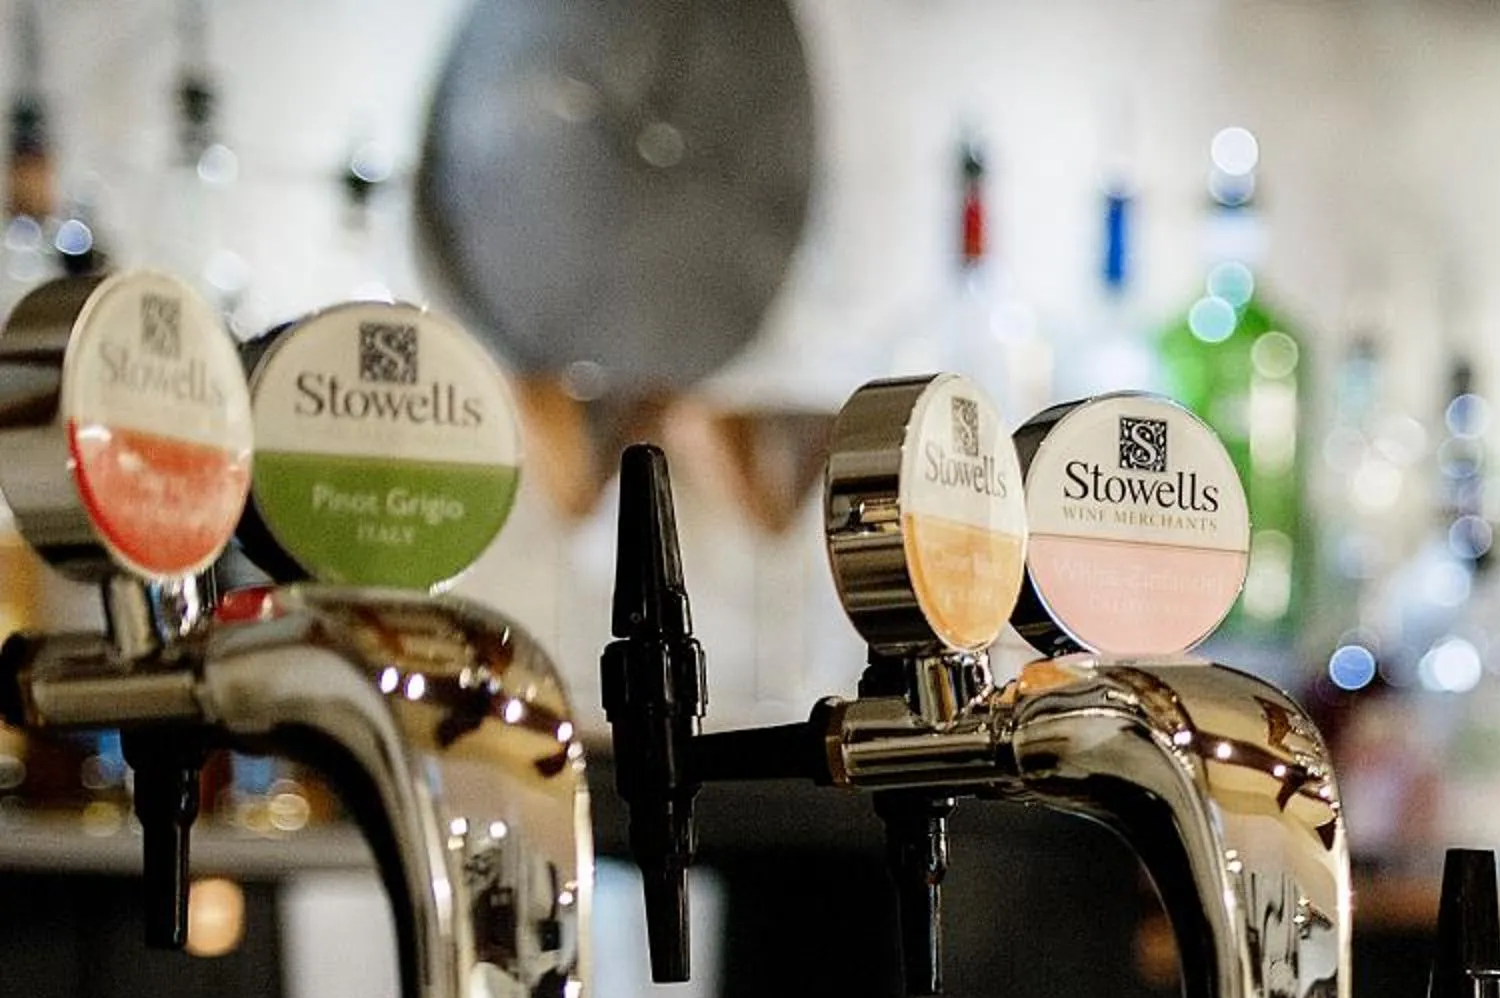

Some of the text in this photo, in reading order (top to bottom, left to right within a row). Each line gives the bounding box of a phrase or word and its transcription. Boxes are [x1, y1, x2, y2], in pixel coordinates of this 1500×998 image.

[294, 371, 483, 426] Stowells
[925, 441, 1007, 498] Stowells
[1063, 459, 1219, 512] Stowells
[1063, 503, 1218, 532] WINE MERCHANTS
